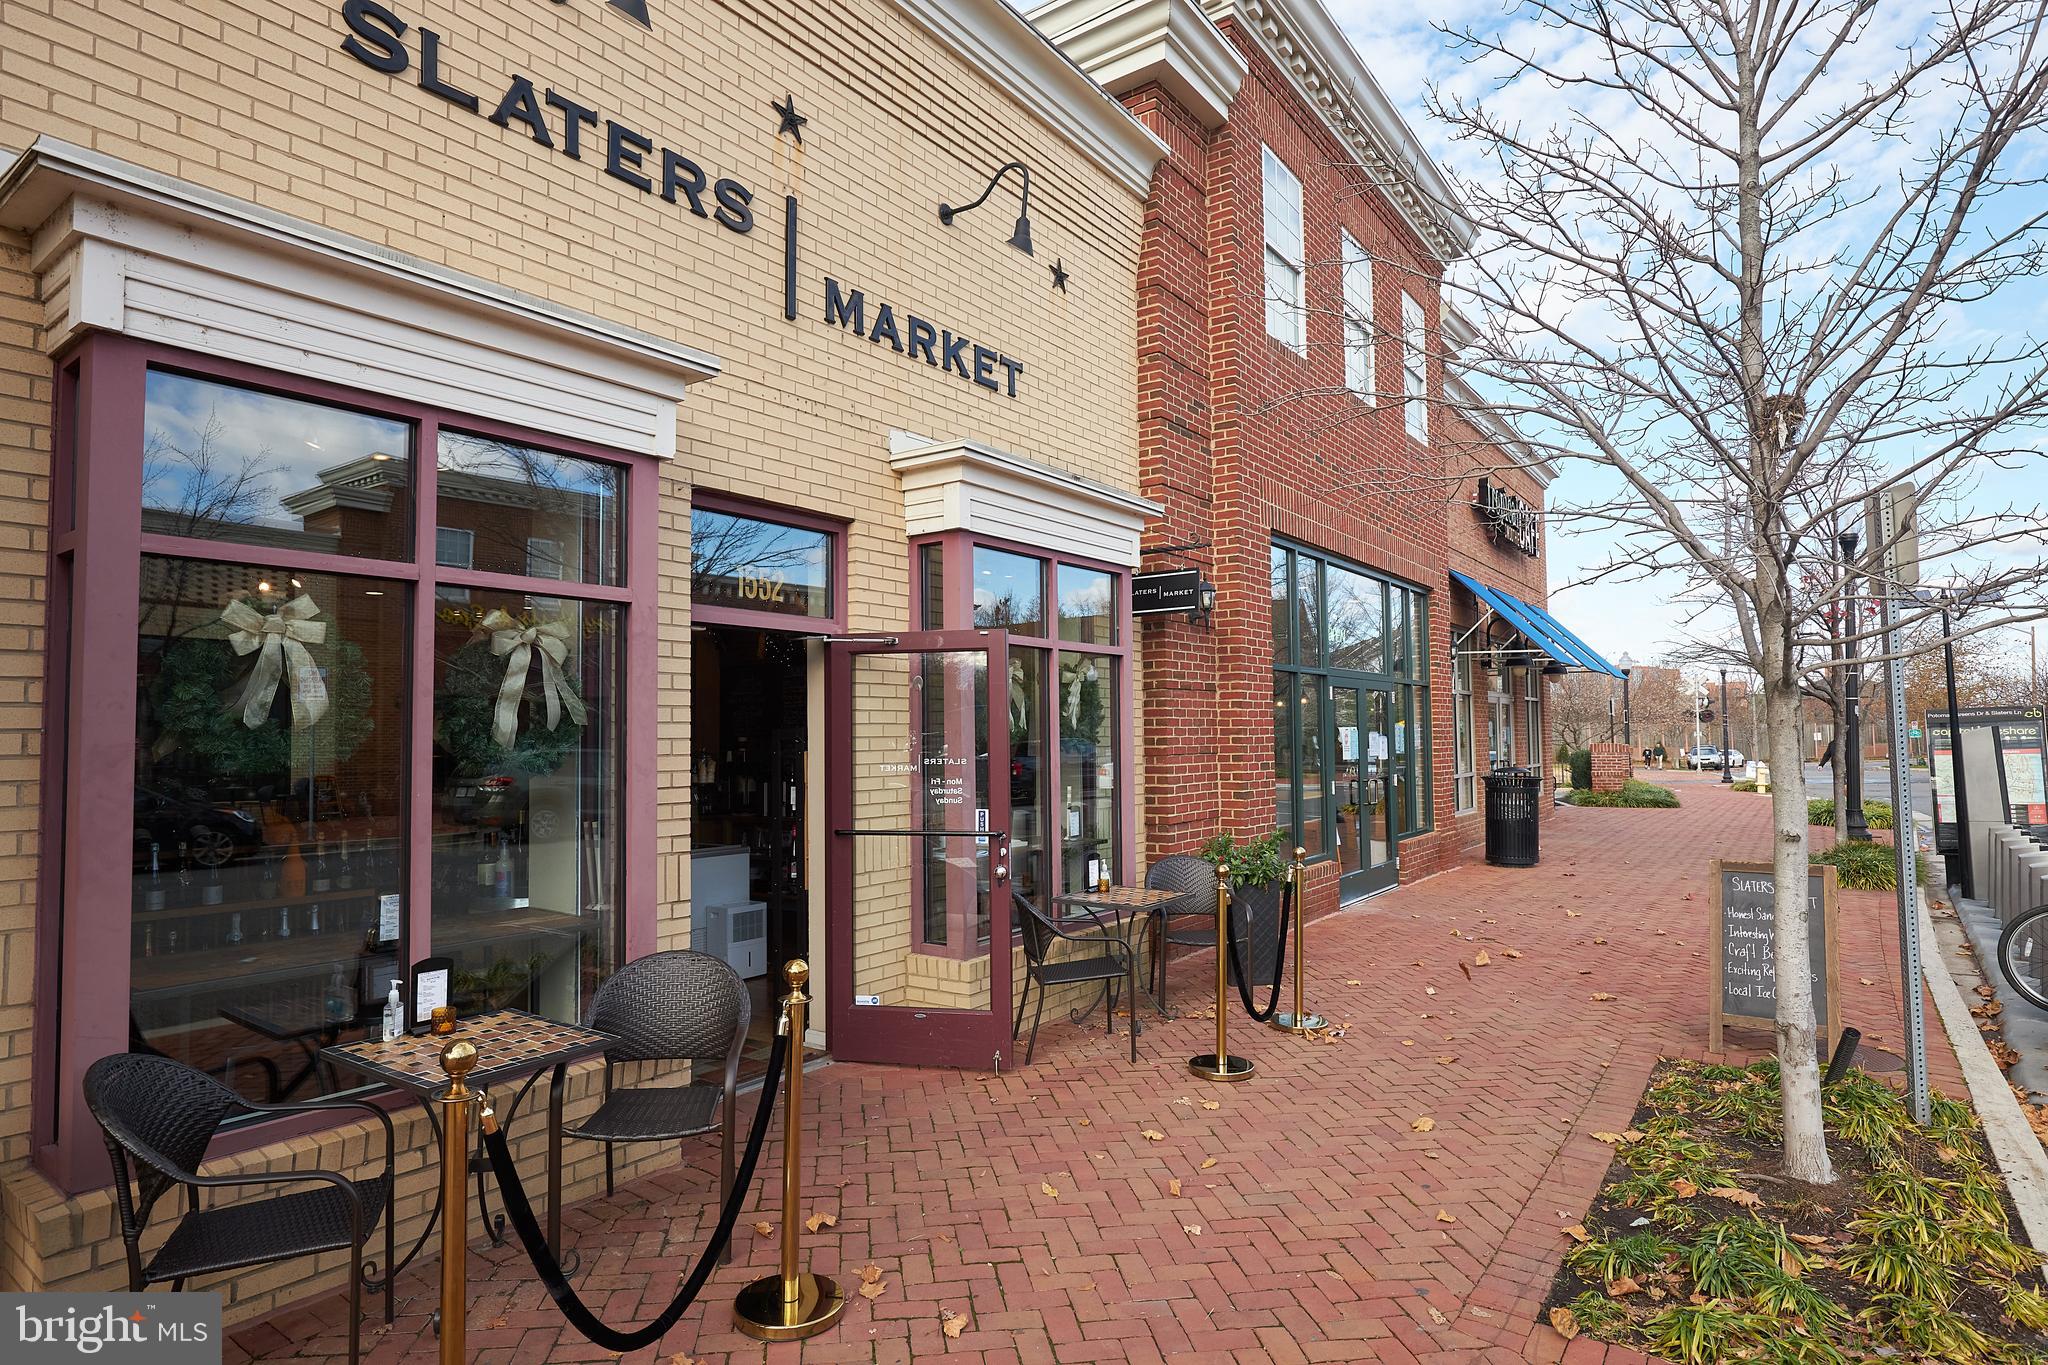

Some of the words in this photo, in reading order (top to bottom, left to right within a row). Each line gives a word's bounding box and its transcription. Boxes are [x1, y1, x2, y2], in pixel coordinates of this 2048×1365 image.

[340, 0, 755, 234] SLATERS
[823, 277, 1024, 398] MARKET
[737, 564, 784, 602] 1552
[1132, 588, 1157, 596] ATERS
[1163, 588, 1194, 597] MARKET
[1731, 876, 1775, 894] SLATERS
[1727, 906, 1754, 919] Honest
[1727, 924, 1769, 945] Interesting
[1728, 941, 1756, 961] Craft
[1727, 961, 1761, 980] Exciting
[1728, 981, 1752, 997] Local
[1755, 985, 1771, 998] Ice
